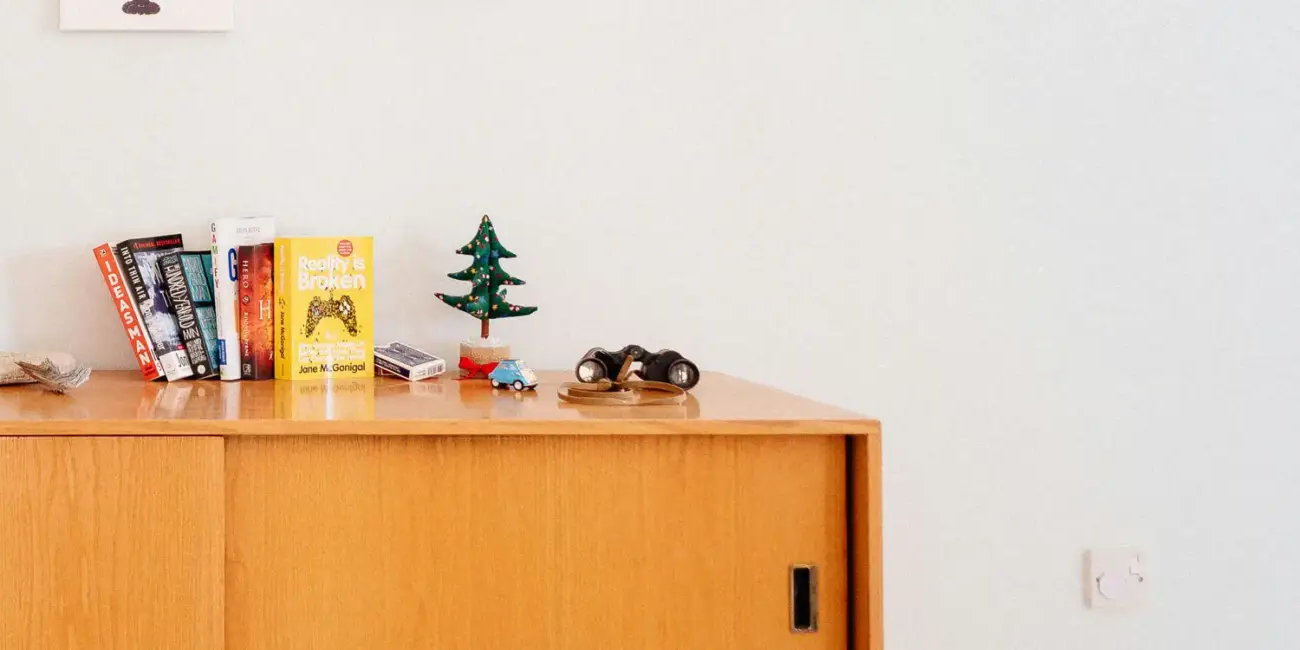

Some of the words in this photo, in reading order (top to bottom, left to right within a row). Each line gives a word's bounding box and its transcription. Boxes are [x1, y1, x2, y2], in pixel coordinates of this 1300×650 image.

[120, 246, 132, 265] INTO
[127, 265, 141, 284] THIN
[134, 284, 147, 300] AIR
[298, 254, 349, 273] Reality
[353, 254, 366, 270] is
[298, 271, 366, 291] Broken
[299, 365, 318, 374] Jane
